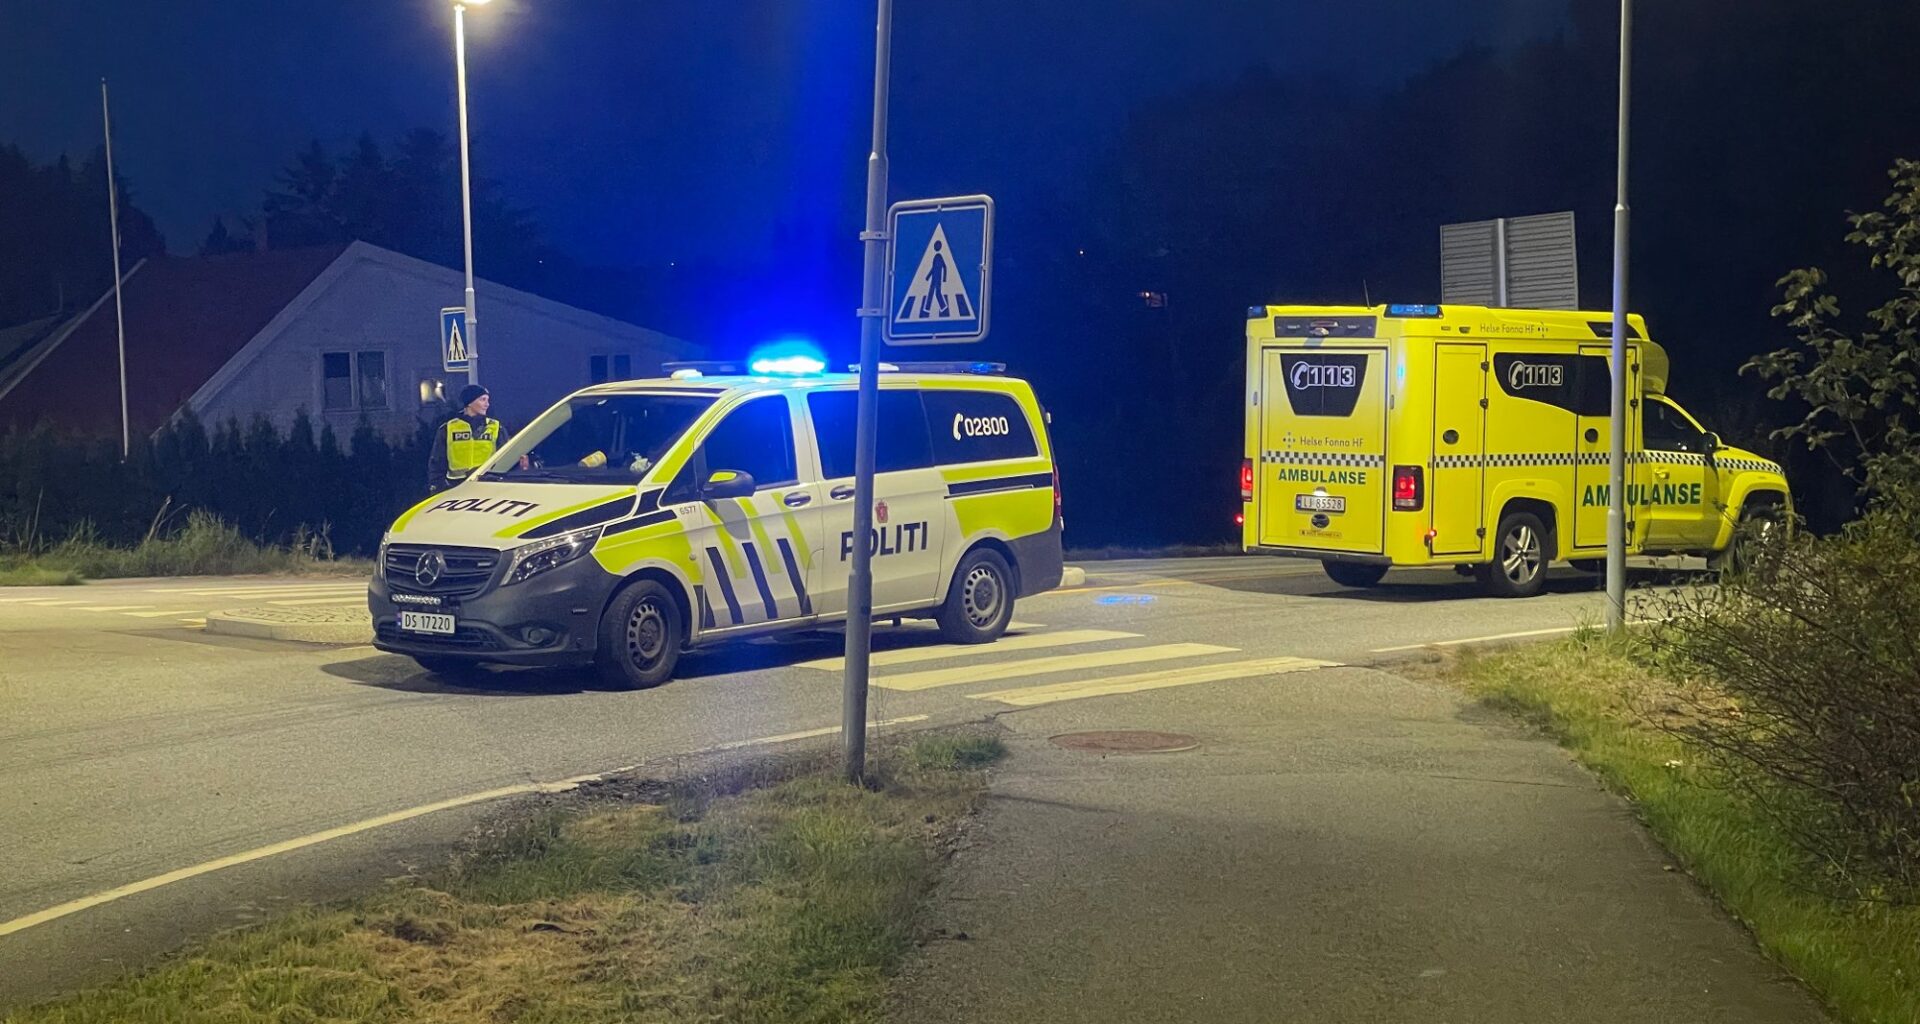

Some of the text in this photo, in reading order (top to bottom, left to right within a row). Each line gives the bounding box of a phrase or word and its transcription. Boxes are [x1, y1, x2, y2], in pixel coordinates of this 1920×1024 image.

[1480, 322, 1500, 333] Helse
[1525, 325, 1535, 334] HF
[1309, 366, 1354, 385] 113
[1525, 366, 1562, 385] 113
[964, 416, 1009, 436] 02800
[1300, 436, 1322, 446] Helse
[1352, 438, 1364, 447] HF
[1279, 468, 1367, 484] AMBULANSE
[1582, 483, 1701, 506] AMULANSE
[425, 498, 540, 517] POLITI
[1315, 499, 1342, 509] 85528
[405, 613, 451, 631] DS 17220
